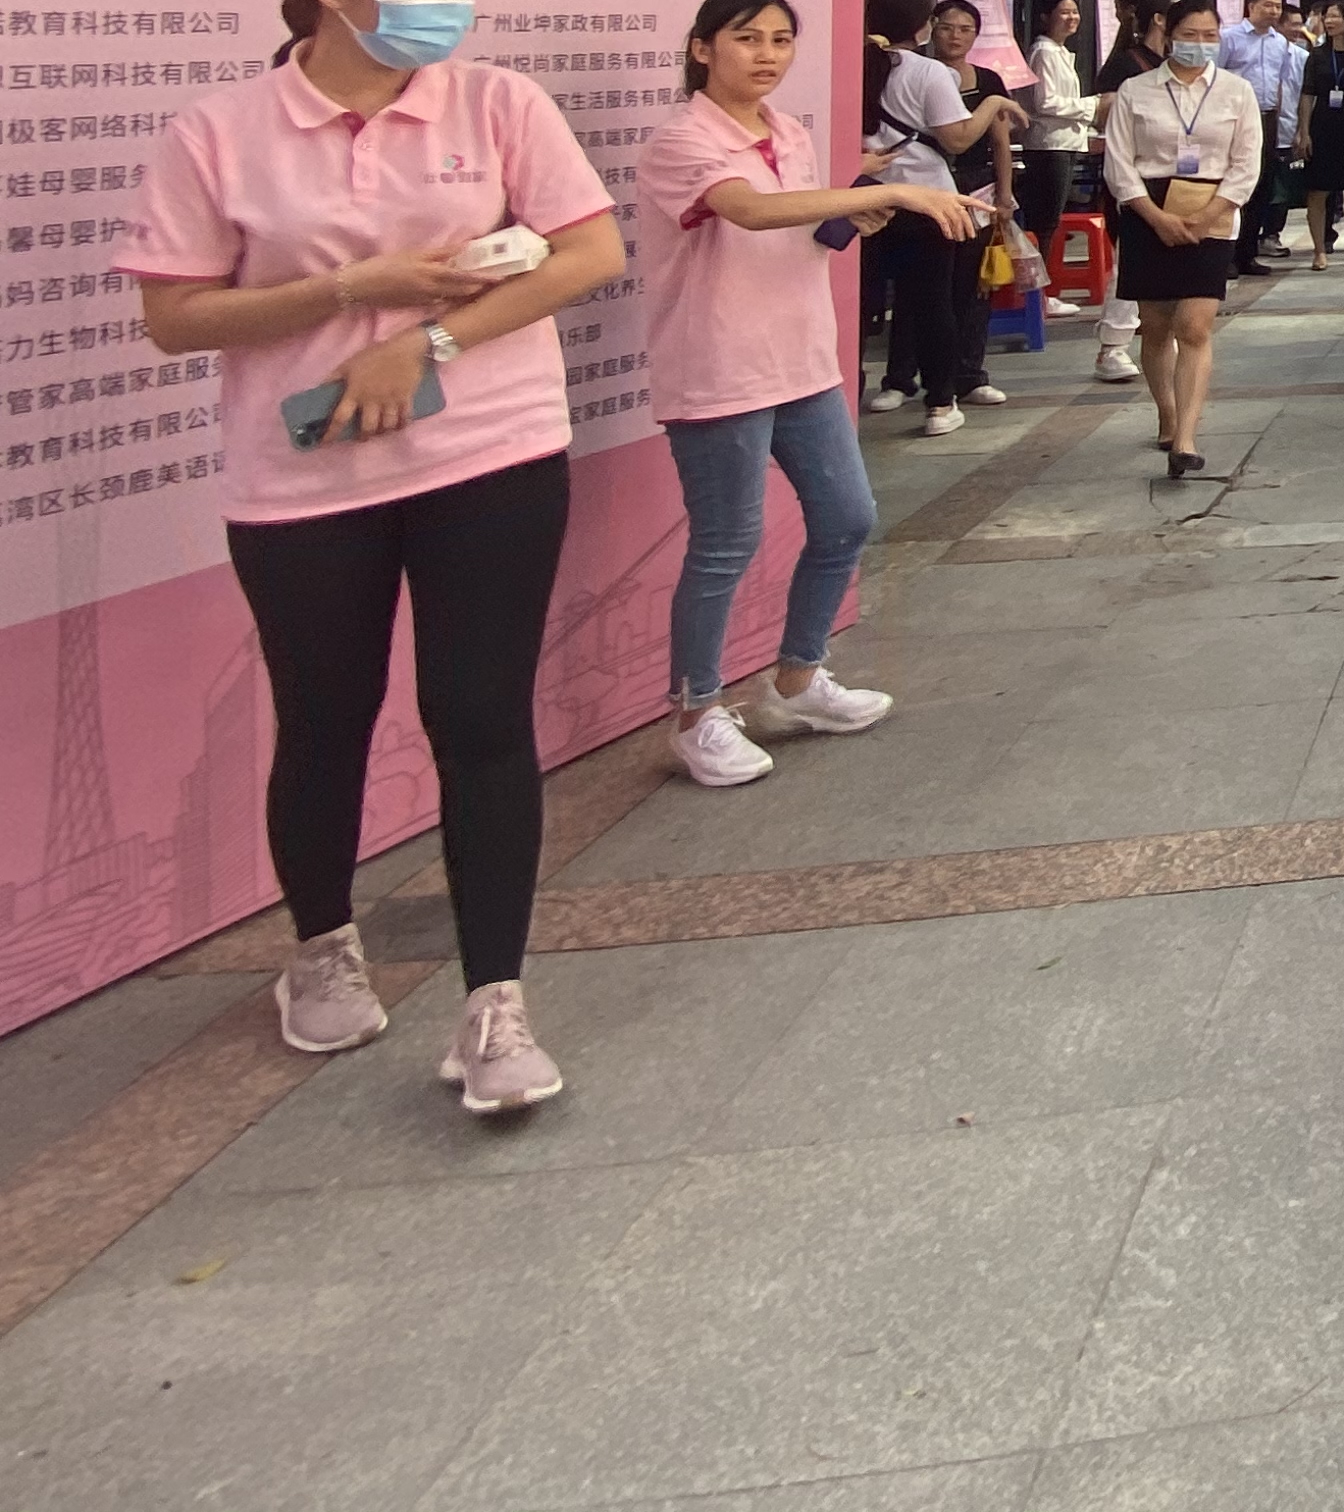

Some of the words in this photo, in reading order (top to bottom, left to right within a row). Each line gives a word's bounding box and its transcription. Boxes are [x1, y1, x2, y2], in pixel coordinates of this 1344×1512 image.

[0, 10, 241, 37] 教育科技有限公司
[0, 60, 265, 90] 互联网科技有限公司
[0, 111, 178, 145] 极客网络科
[0, 164, 147, 199] 娃母婴服务
[0, 272, 141, 309] 妈咨询有
[0, 318, 148, 364] 力生物科技
[0, 355, 222, 416] 管家高端家庭服
[0, 402, 221, 471] 教育科技有限公
[0, 449, 226, 528] 湾区长颈鹿美语
